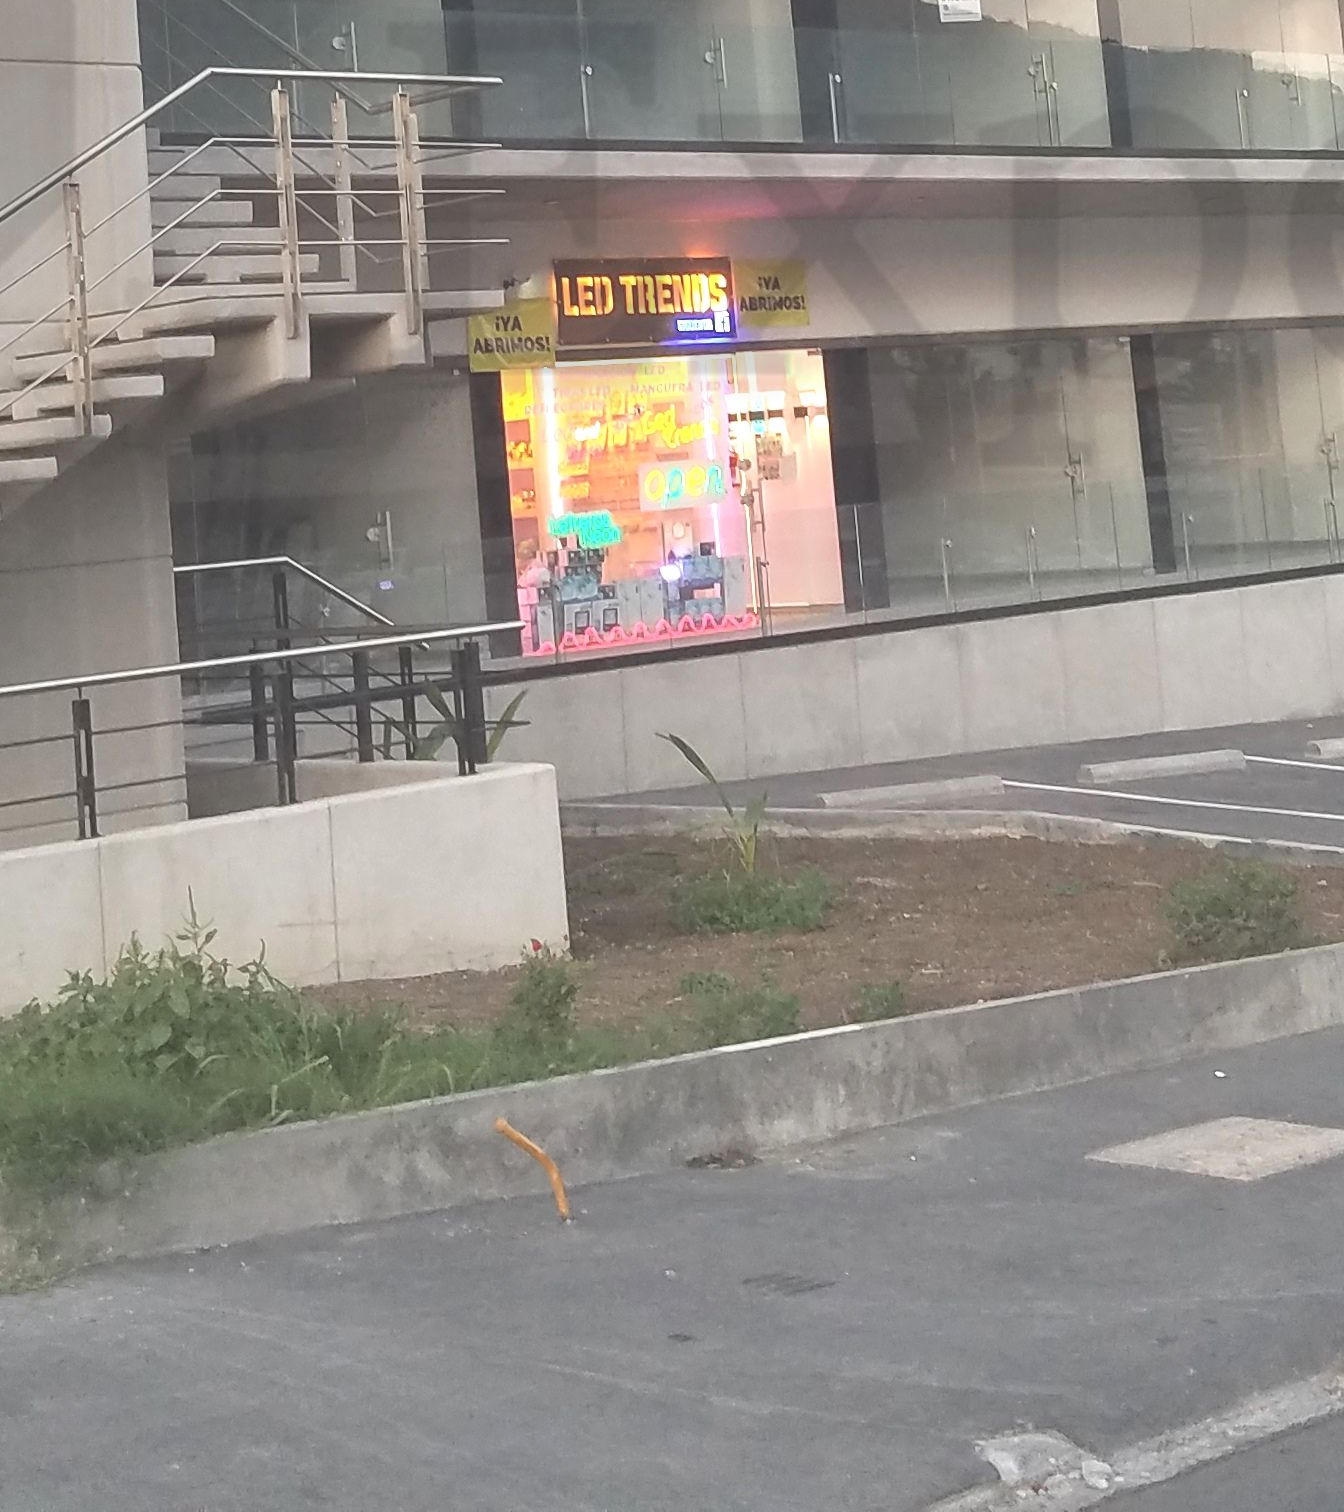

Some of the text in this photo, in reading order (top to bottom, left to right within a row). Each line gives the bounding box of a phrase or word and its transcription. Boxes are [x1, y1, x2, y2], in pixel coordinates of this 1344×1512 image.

[758, 274, 782, 292] ¡YA
[561, 272, 729, 317] LED TRENDS
[739, 295, 806, 312] ABRIMOS!
[495, 315, 523, 333] ¡YA
[473, 336, 551, 356] ABRIMOS!
